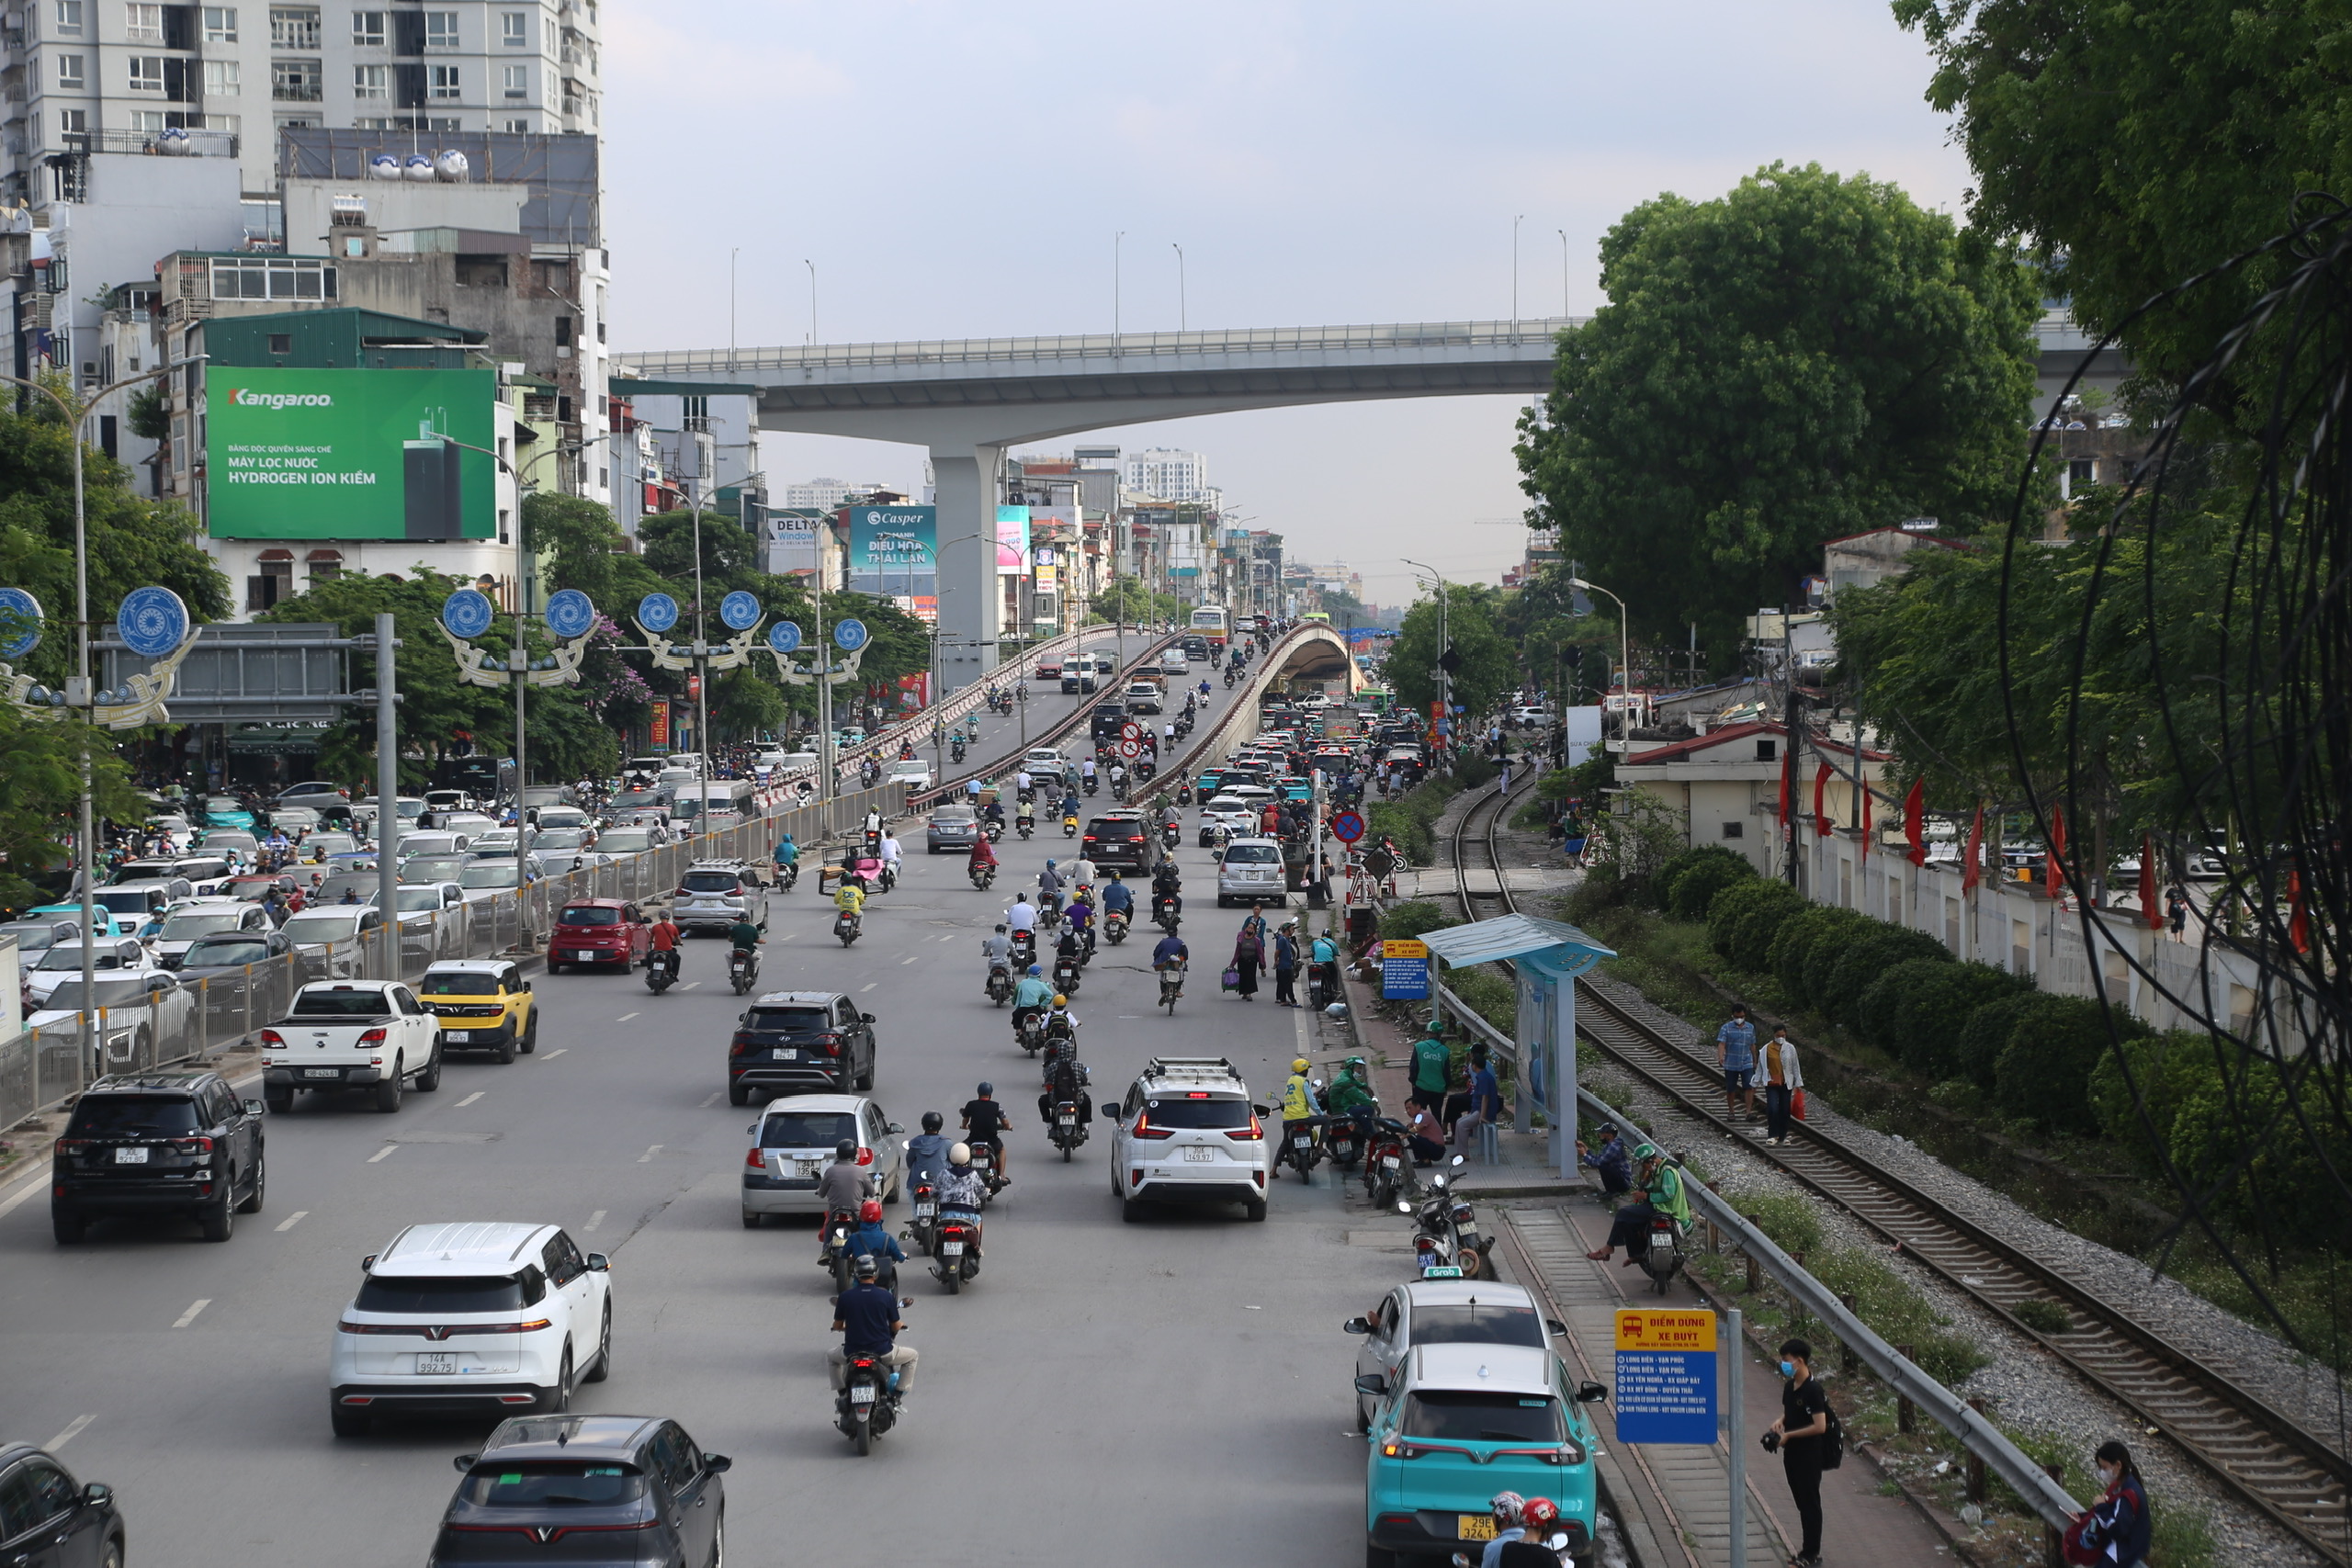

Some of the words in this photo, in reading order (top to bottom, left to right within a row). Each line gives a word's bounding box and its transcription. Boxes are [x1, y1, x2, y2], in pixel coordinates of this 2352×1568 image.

[228, 388, 331, 410] Kangaroo
[259, 457, 281, 470] LỌC
[229, 472, 307, 484] HYDROGEN
[311, 472, 336, 484] ION
[882, 513, 923, 525] Casper
[777, 520, 818, 531] DELTA
[1424, 1052, 1442, 1061] Grab
[1650, 1315, 1675, 1326] ĐIỂM
[1679, 1316, 1705, 1327] DỪNG
[1658, 1333, 1670, 1341] XE
[1674, 1330, 1699, 1341] BUÝT
[430, 1354, 445, 1363] 14A
[421, 1364, 452, 1372] 992.75
[1472, 1518, 1491, 1528] 29E
